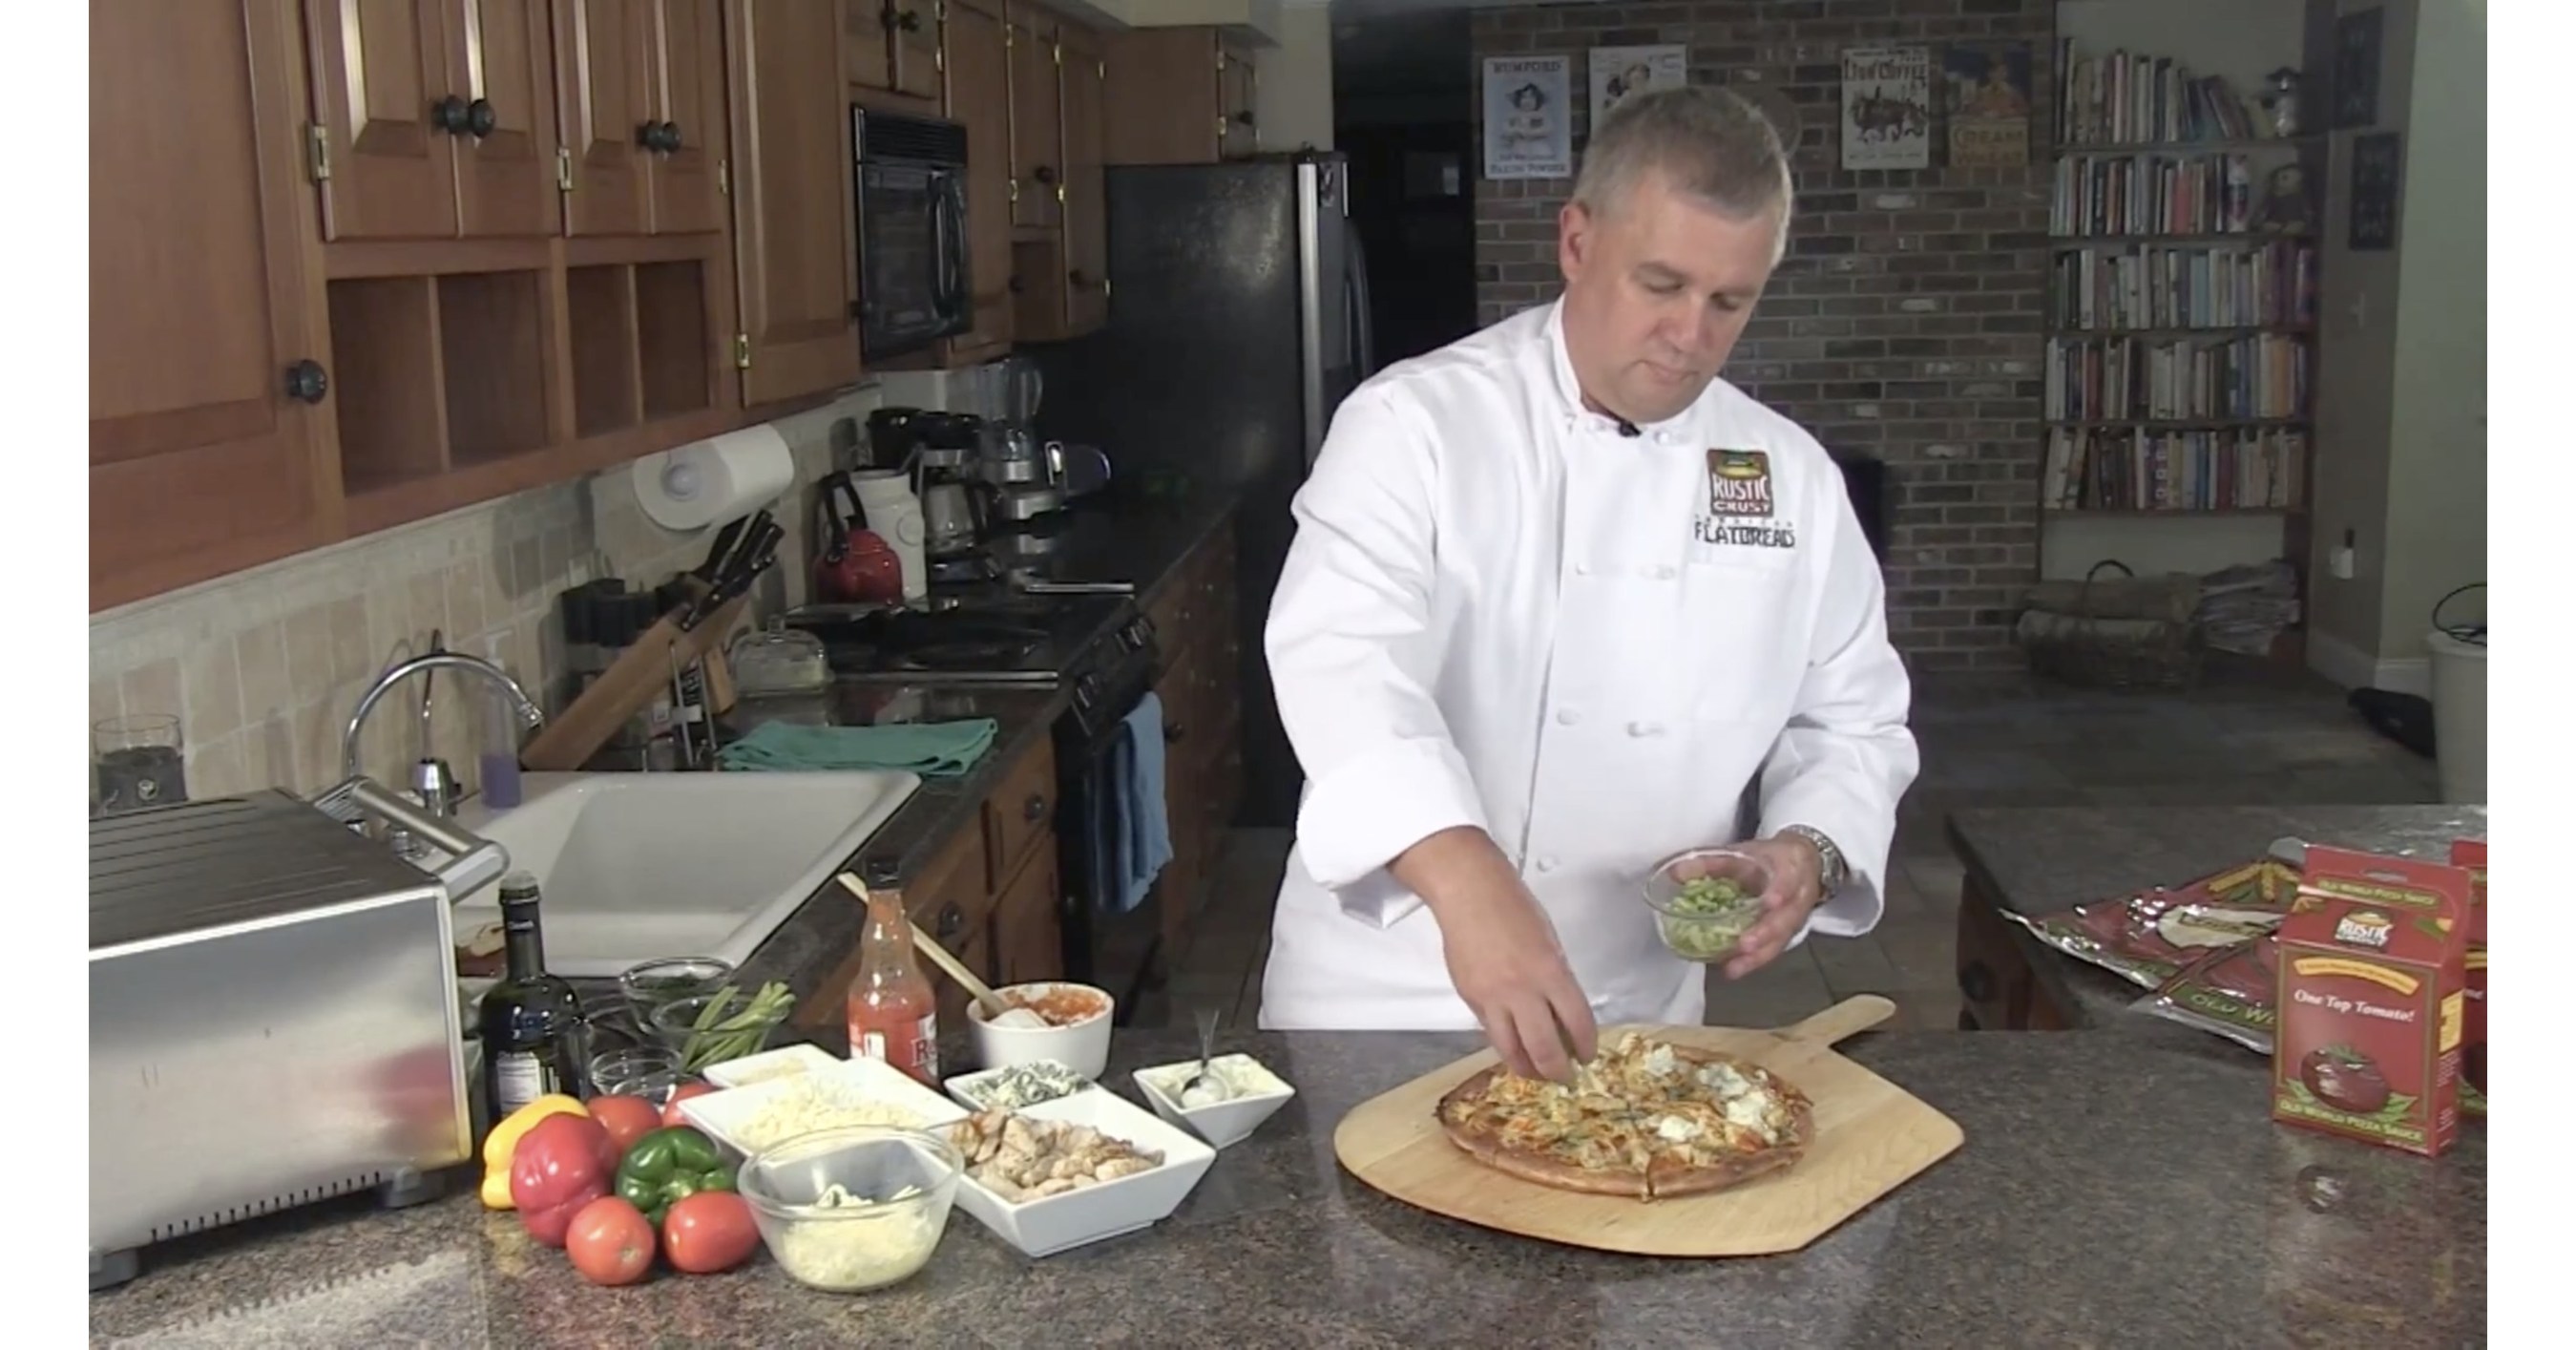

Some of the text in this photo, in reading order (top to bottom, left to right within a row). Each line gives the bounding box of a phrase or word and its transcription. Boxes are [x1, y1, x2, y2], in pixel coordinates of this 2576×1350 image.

[1493, 60, 1562, 74] RUMFORD
[1712, 474, 1770, 500] RUSTIC
[1713, 500, 1770, 513] CRUST
[1695, 521, 1795, 548] FLATBREAD
[2336, 917, 2394, 942] RUSTIC
[2190, 994, 2239, 1013] OLD
[2293, 989, 2416, 1023] One Top Tomato!
[2280, 1099, 2303, 1113] OLD
[2346, 1116, 2381, 1132] PIZZA
[2382, 1124, 2423, 1143] SAUCE
